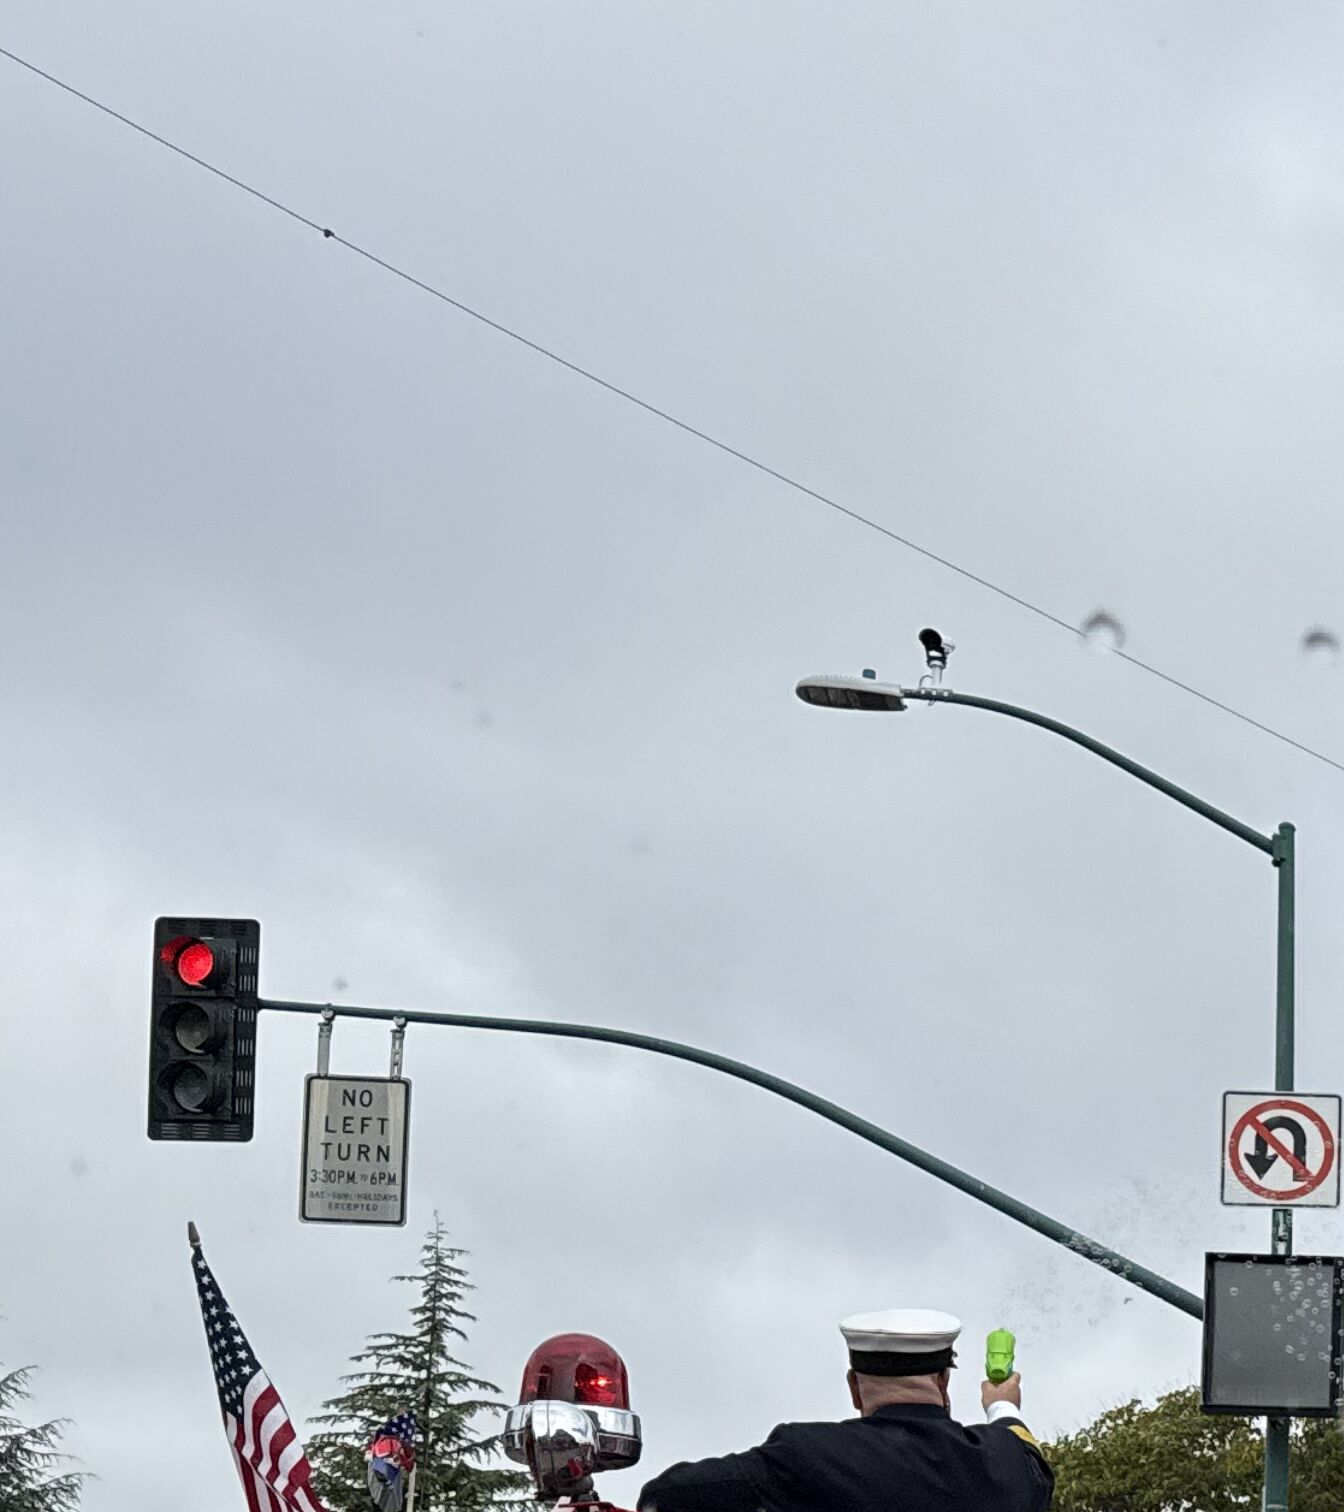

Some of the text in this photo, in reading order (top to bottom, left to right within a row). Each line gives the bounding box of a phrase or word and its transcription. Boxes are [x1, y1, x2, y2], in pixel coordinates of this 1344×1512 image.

[342, 1088, 373, 1108] NO
[324, 1115, 390, 1136] LEFT
[320, 1142, 391, 1163] TURN
